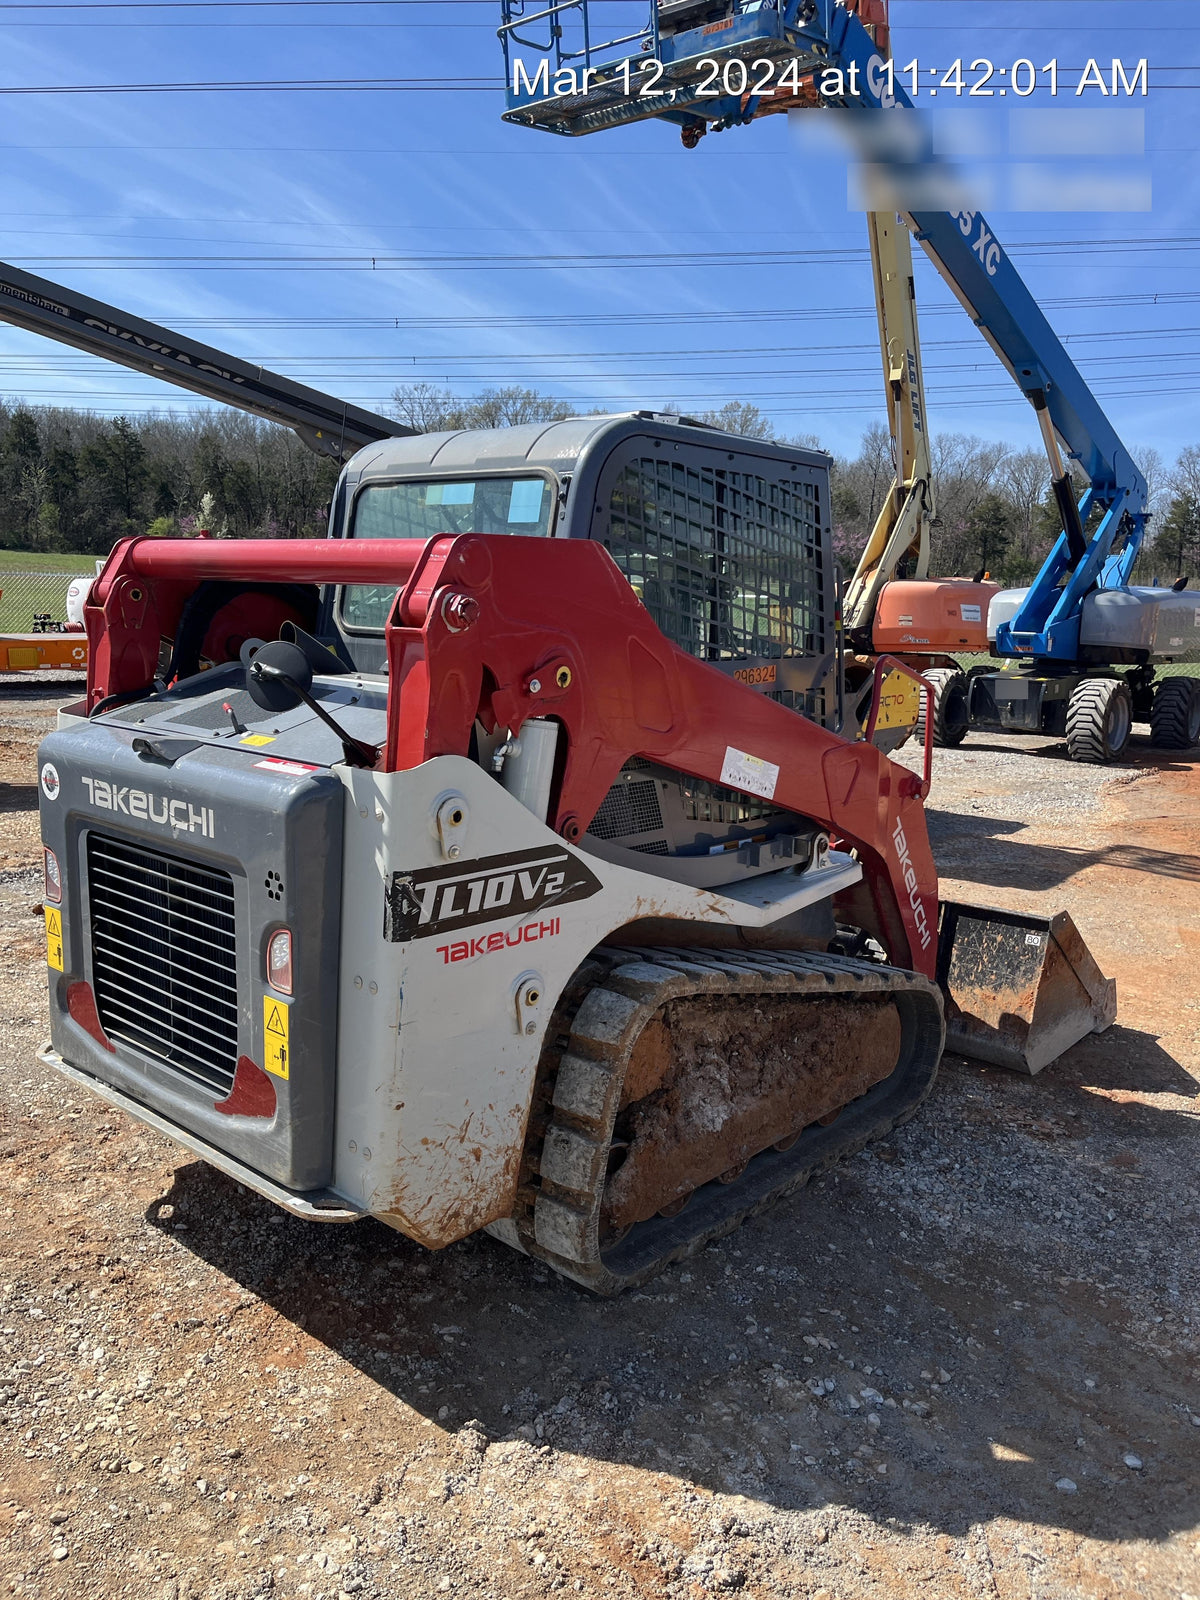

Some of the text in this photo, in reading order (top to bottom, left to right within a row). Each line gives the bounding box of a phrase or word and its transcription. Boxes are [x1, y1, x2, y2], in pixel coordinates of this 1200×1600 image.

[906, 348, 922, 432] JLG LIFT
[734, 665, 775, 684] 296324
